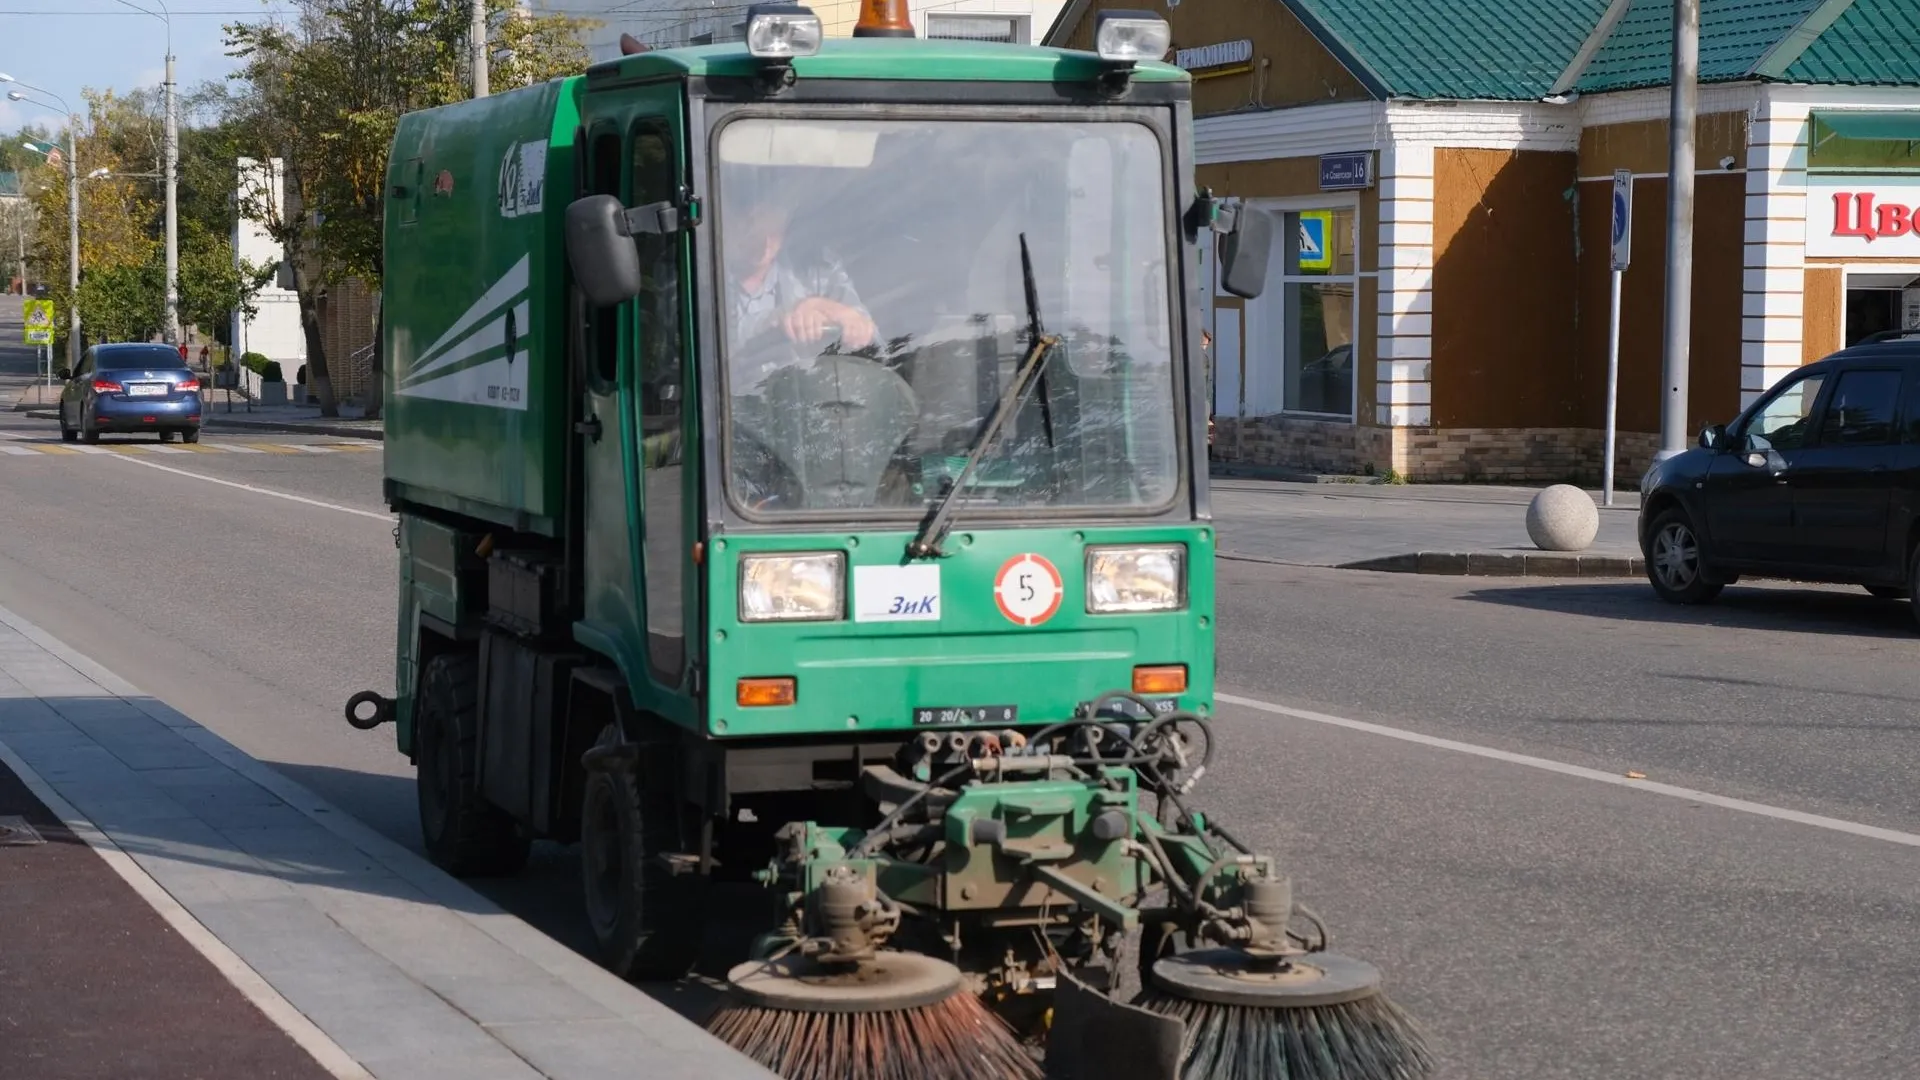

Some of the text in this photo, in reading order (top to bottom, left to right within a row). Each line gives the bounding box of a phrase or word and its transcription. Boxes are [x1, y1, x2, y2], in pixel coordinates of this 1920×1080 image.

[1355, 163, 1364, 178] 16
[1020, 575, 1034, 601] 5
[889, 596, 936, 614] ЗиК
[919, 711, 932, 722] 20
[940, 708, 967, 722] 20/
